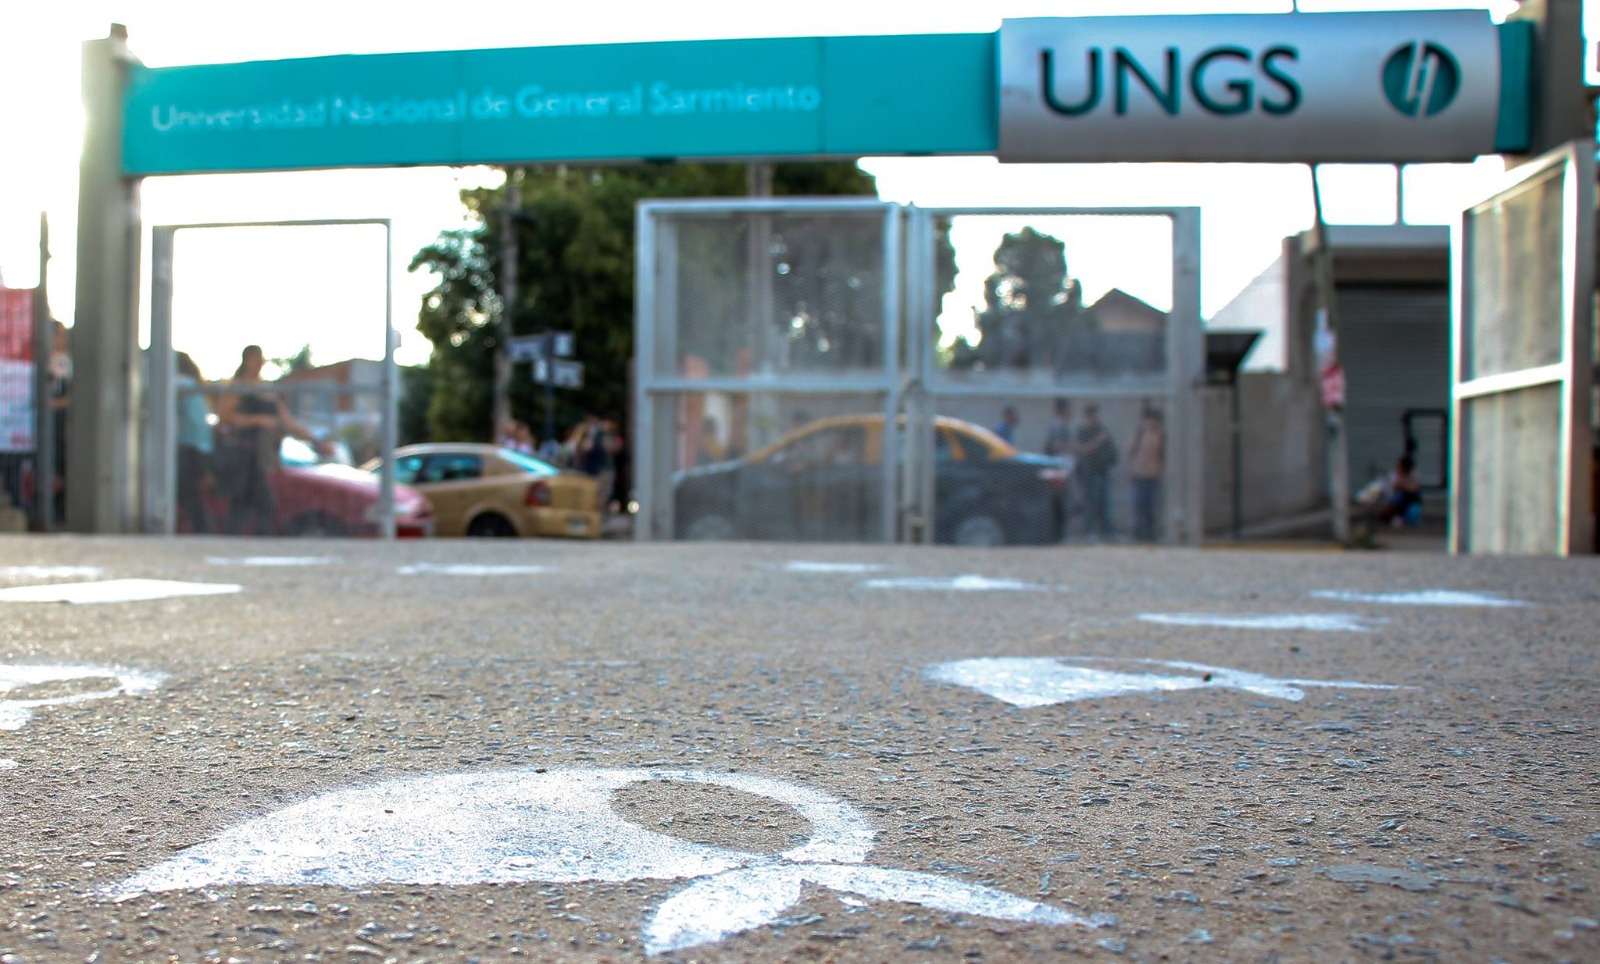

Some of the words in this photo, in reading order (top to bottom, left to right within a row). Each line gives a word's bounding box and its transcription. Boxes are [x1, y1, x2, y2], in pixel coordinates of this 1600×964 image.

[152, 96, 324, 132] Universidad
[331, 91, 466, 127] Nacional
[471, 88, 510, 120] de
[515, 83, 642, 118] General
[650, 81, 821, 116] Sarmiento
[1039, 44, 1303, 117] UNGS
